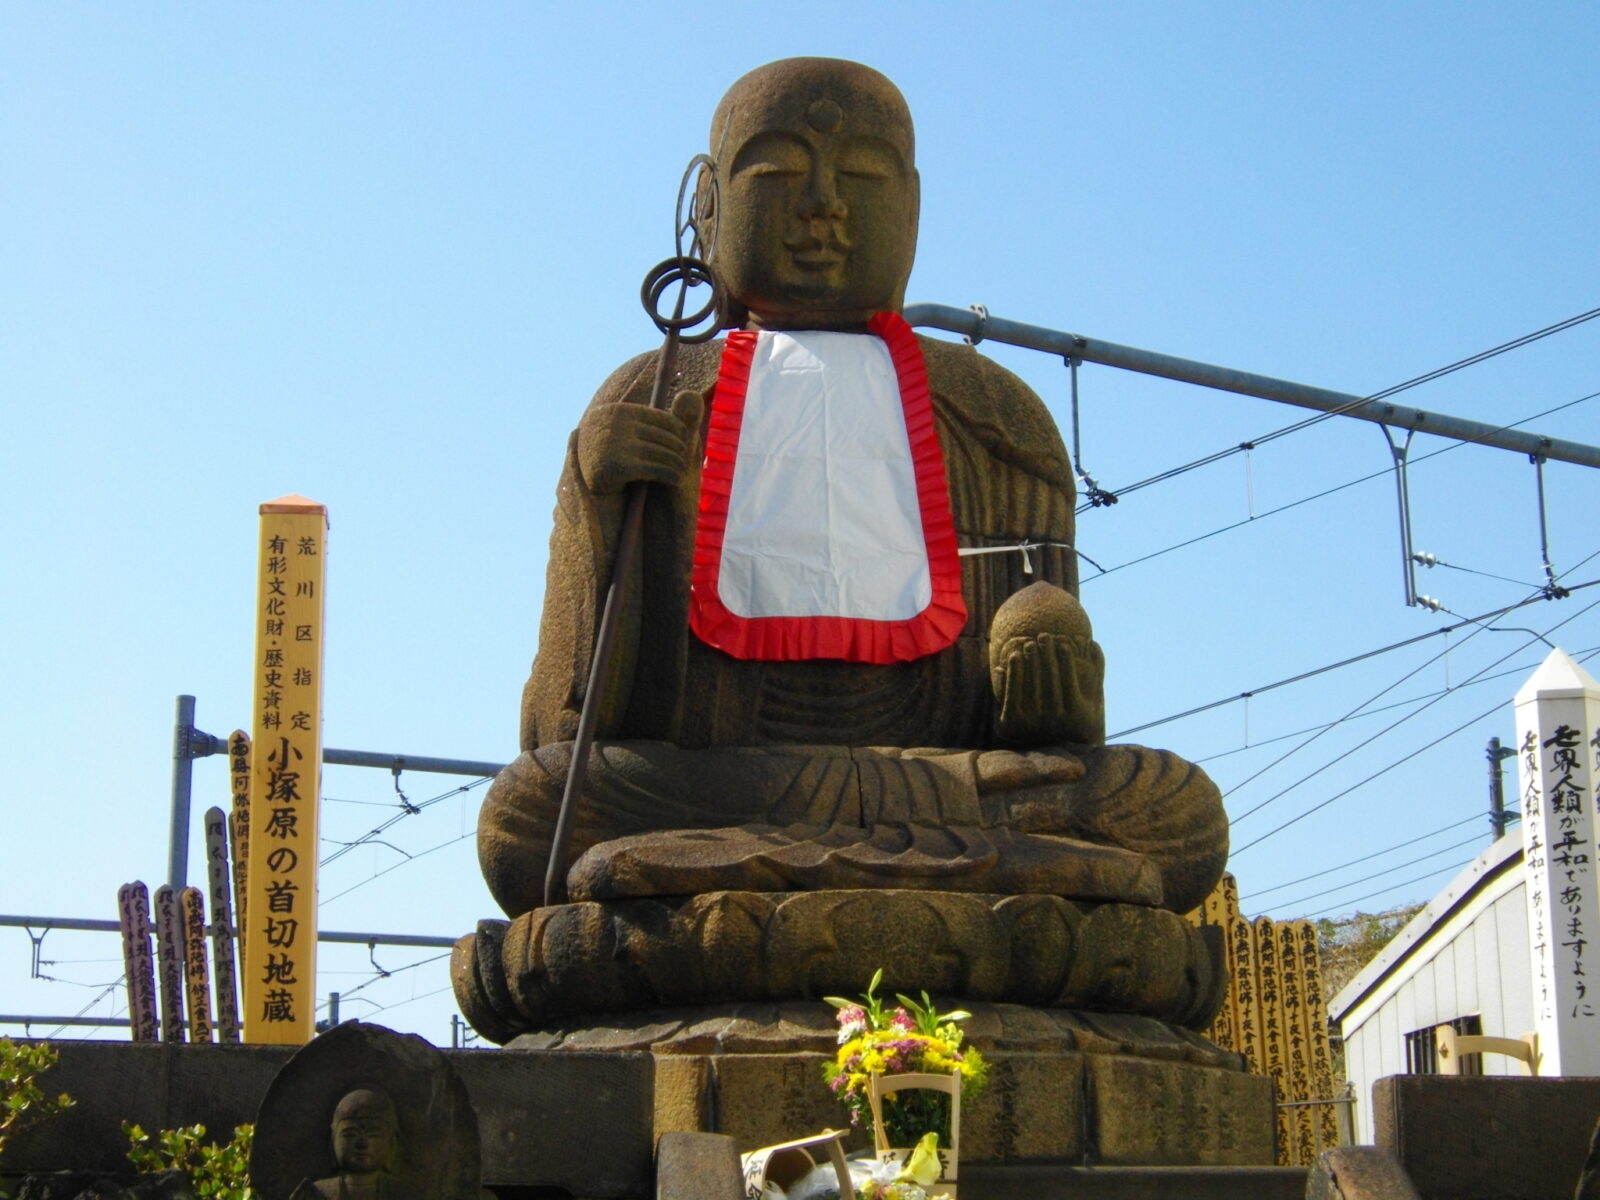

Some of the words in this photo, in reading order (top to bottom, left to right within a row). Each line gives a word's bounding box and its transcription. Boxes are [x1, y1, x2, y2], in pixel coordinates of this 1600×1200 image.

[262, 534, 289, 731] 有形文化財・歴史資料
[291, 536, 317, 731] 荒川区指定
[261, 736, 303, 1023] 小塚原の首切地蔵
[1543, 724, 1595, 1018] 世界人類が平和でありますように
